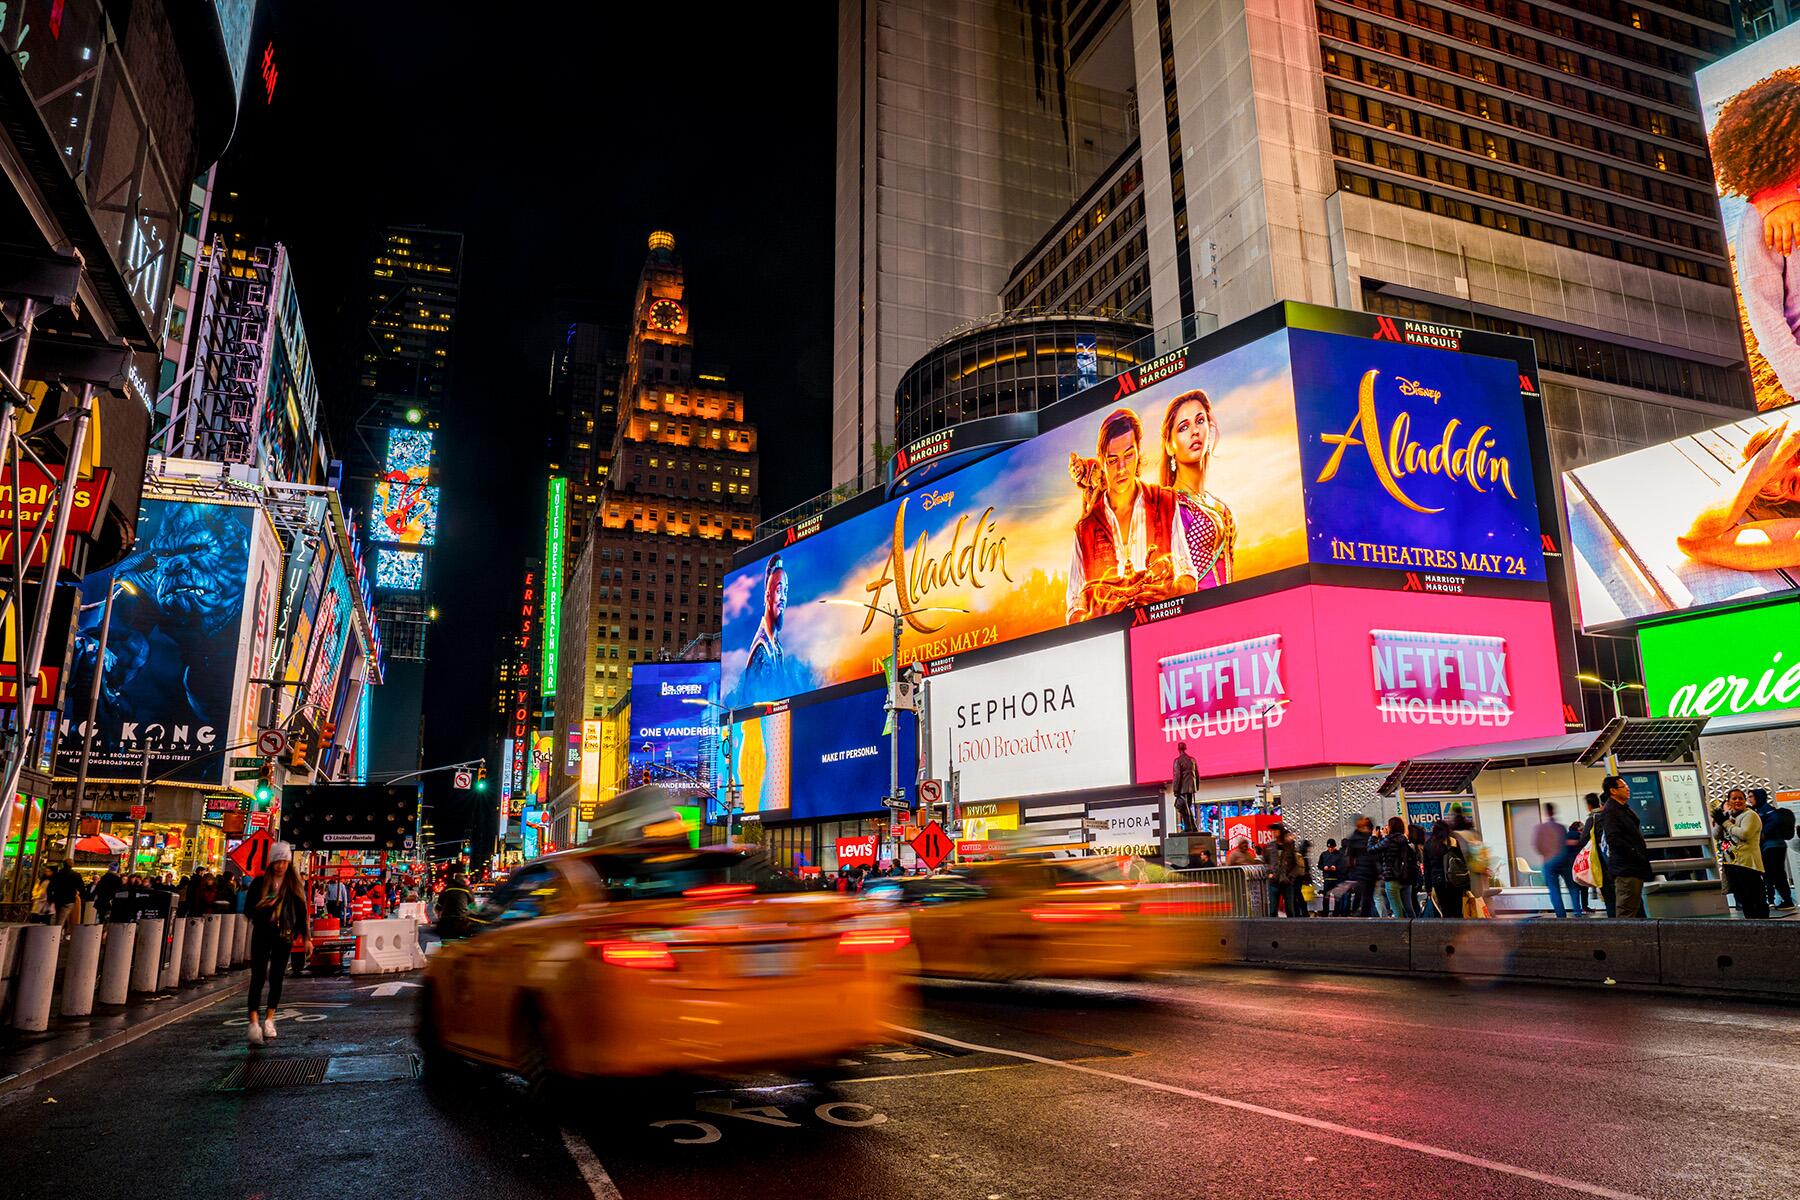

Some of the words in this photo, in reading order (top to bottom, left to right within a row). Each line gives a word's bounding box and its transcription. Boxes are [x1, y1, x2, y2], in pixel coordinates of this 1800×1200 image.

[1405, 321, 1463, 340] MARRIOTT
[1406, 332, 1459, 350] MARQUIS
[1140, 346, 1189, 376] MARRIOTT
[1140, 360, 1184, 386] MARQUIS
[910, 428, 955, 453] MARRIOTT
[1315, 369, 1518, 514] Aladdin
[910, 440, 950, 463] MARQUIS
[553, 482, 561, 539] VOTED
[798, 514, 823, 531] MARRIOTT
[798, 523, 820, 539] MARQUIS
[861, 498, 1014, 635] Aladdin
[1331, 540, 1356, 560] IN
[1358, 543, 1457, 568] THEATRES
[1460, 552, 1502, 573] MAY
[1504, 557, 1527, 575] 24
[1425, 574, 1465, 585] MARRIOTT
[1425, 583, 1462, 593] MARQUIS
[521, 573, 534, 649] ERNST
[1150, 598, 1185, 612] MARRIOTT
[1150, 607, 1181, 620] MARQUIS
[872, 658, 885, 674] IN
[899, 638, 948, 667] HEATRES
[950, 631, 981, 654] MAY
[982, 625, 998, 645] 24
[518, 664, 529, 676] &
[930, 657, 954, 668] MARRIOTT
[930, 663, 952, 674] MARQUIS
[1371, 645, 1511, 697] NETFLIX
[1158, 649, 1286, 715] NETFLIX
[1668, 651, 1800, 718] aerie
[957, 684, 1076, 729] SEPHORA
[1381, 695, 1511, 727] INCLUDED
[513, 691, 528, 771] YOUNG
[640, 728, 661, 737] ONE
[664, 726, 720, 736] VANDERBILT
[1165, 704, 1284, 743] INCLUDED
[121, 722, 216, 744] KONG
[119, 741, 214, 752] BRADWAY
[822, 752, 839, 763] MAKE
[839, 751, 846, 761] IT
[845, 745, 878, 759] PERSONAL
[958, 738, 991, 763] 1500
[994, 729, 1077, 755] Broadway
[246, 759, 256, 767] 46
[1664, 775, 1693, 783] NOVA
[967, 804, 998, 816] INVICTA
[1410, 814, 1440, 824] WEDG
[1111, 816, 1151, 829] PHORA
[1674, 821, 1702, 830] solstreet
[185, 839, 193, 857] ATM
[1092, 843, 1151, 857] SEPHORA
